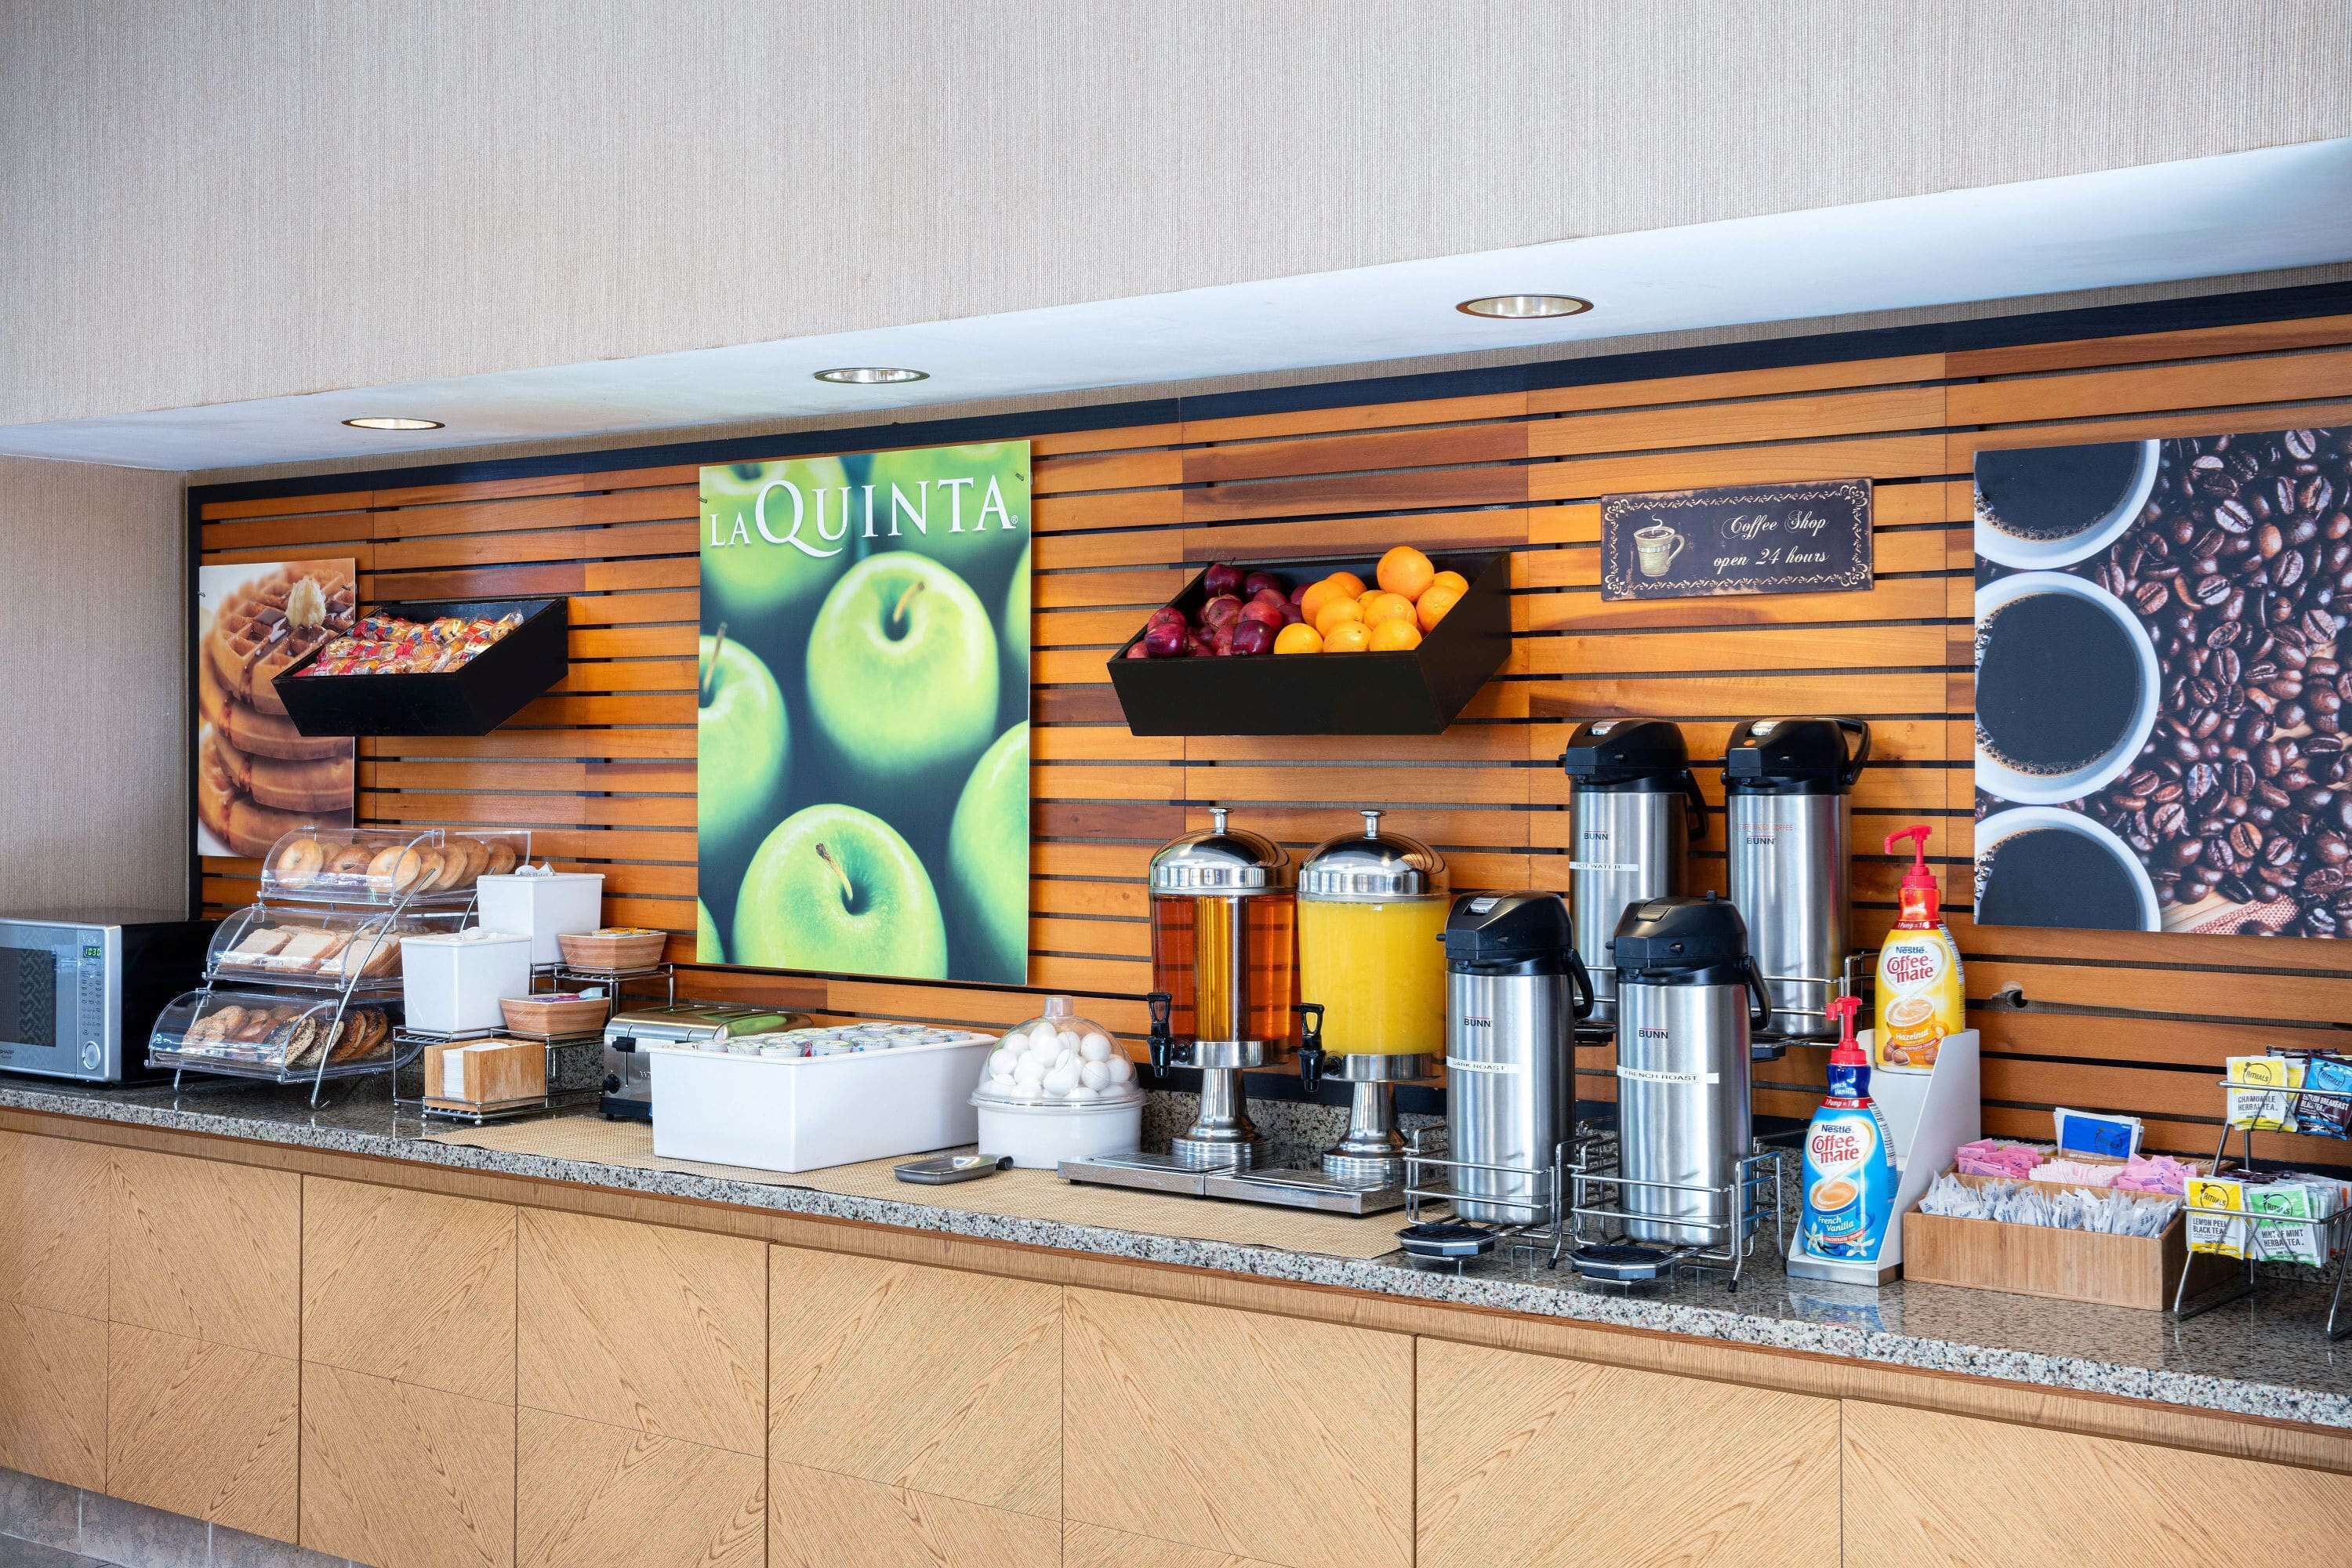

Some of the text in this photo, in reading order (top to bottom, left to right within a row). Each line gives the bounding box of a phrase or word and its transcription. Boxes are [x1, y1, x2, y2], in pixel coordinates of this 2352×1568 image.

[710, 474, 1017, 557] LA QUINTA
[1722, 510, 1829, 540] Coffee Shop
[1714, 545, 1830, 574] open 24 hours
[1896, 967, 1933, 983] mate
[1464, 1018, 1491, 1028] BUNN
[1639, 1029, 1668, 1039] BUNN
[1624, 1070, 1658, 1079] FRENCH
[2245, 1071, 2270, 1082] RITUALS
[2320, 1097, 2350, 1111] BREAKFAST
[1820, 1148, 1860, 1163] mate
[2203, 1192, 2227, 1207] RITUALS
[1819, 1215, 1842, 1225] French
[2193, 1218, 2212, 1227] LEMON
[1826, 1220, 1855, 1232] Vanilla
[2193, 1225, 2211, 1234] BLACK
[2285, 1229, 2303, 1238] MINT
